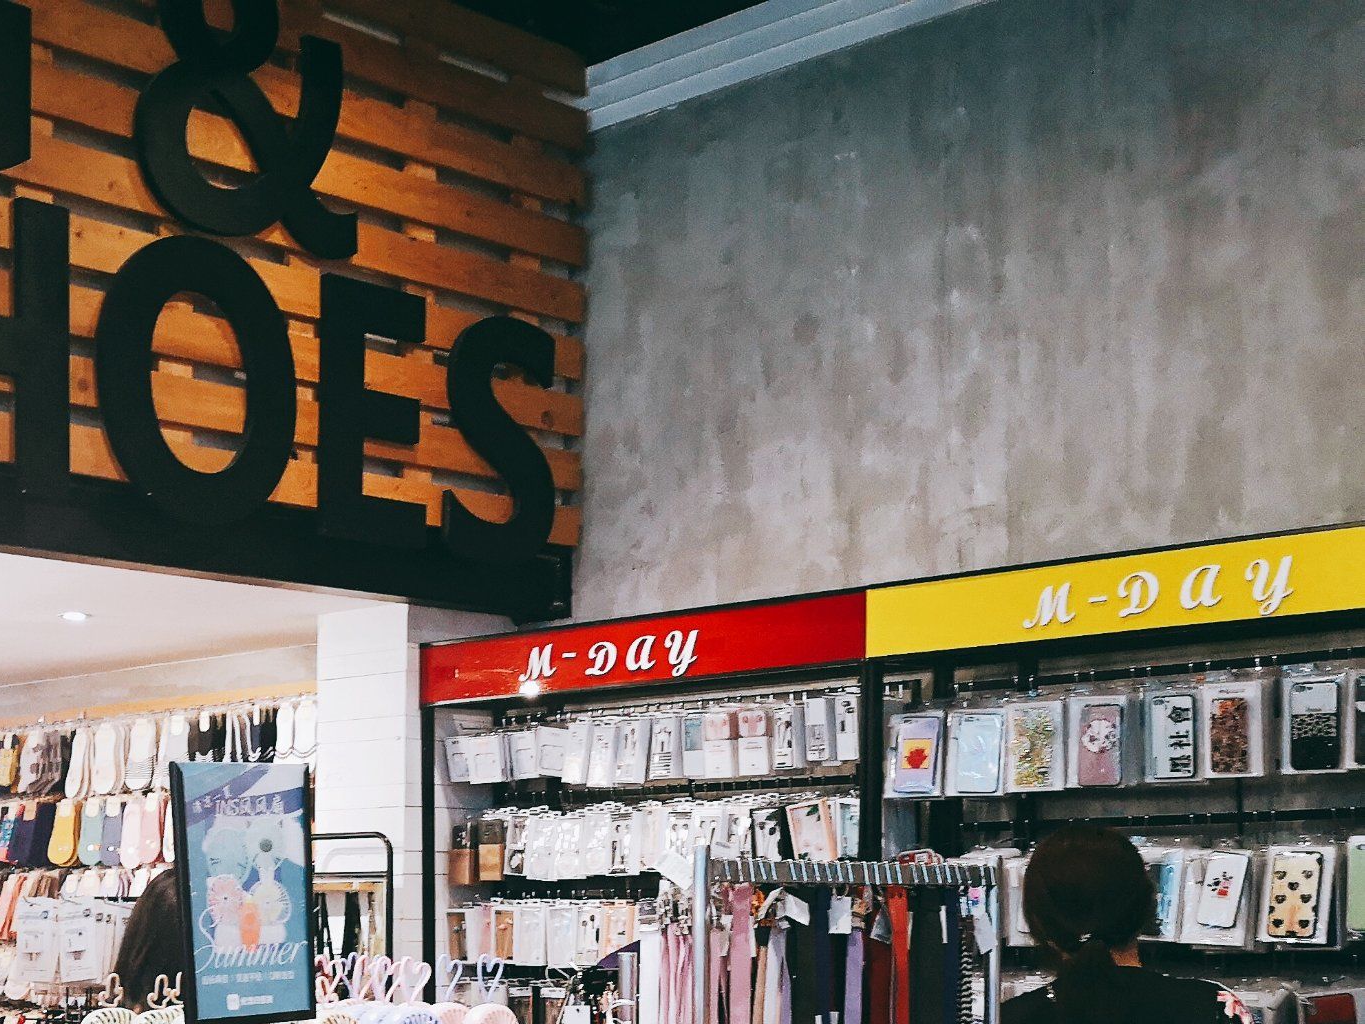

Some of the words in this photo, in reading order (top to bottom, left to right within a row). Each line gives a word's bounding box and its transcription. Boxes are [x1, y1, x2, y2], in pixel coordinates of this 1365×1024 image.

[134, 0, 357, 260] &
[1021, 554, 1295, 630] M-DAY
[518, 629, 700, 683] M-DAY
[193, 906, 308, 974] Summer
